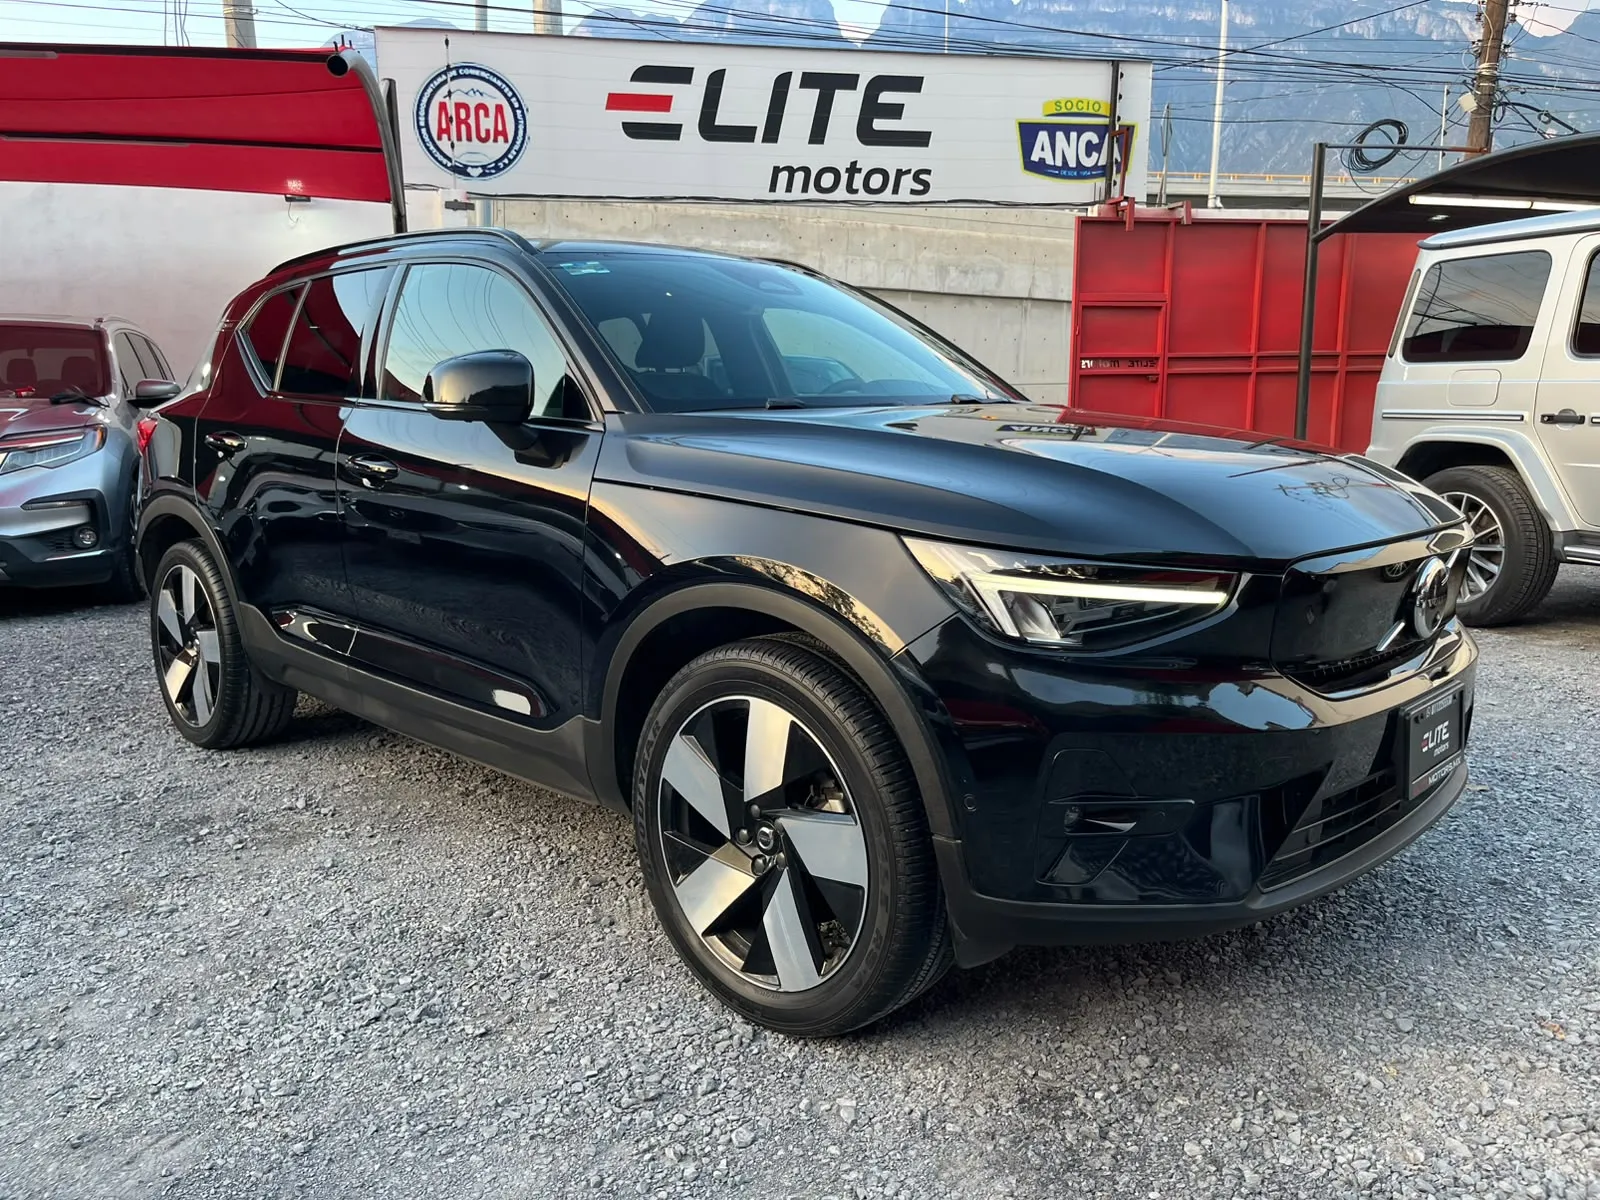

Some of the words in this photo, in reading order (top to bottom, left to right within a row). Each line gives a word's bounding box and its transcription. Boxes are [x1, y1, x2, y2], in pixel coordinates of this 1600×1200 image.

[437, 101, 509, 144] ARCA
[605, 65, 932, 148] ELITE
[1054, 100, 1101, 112] SOCIO
[768, 160, 932, 195] motors
[1421, 720, 1449, 753] ELITE
